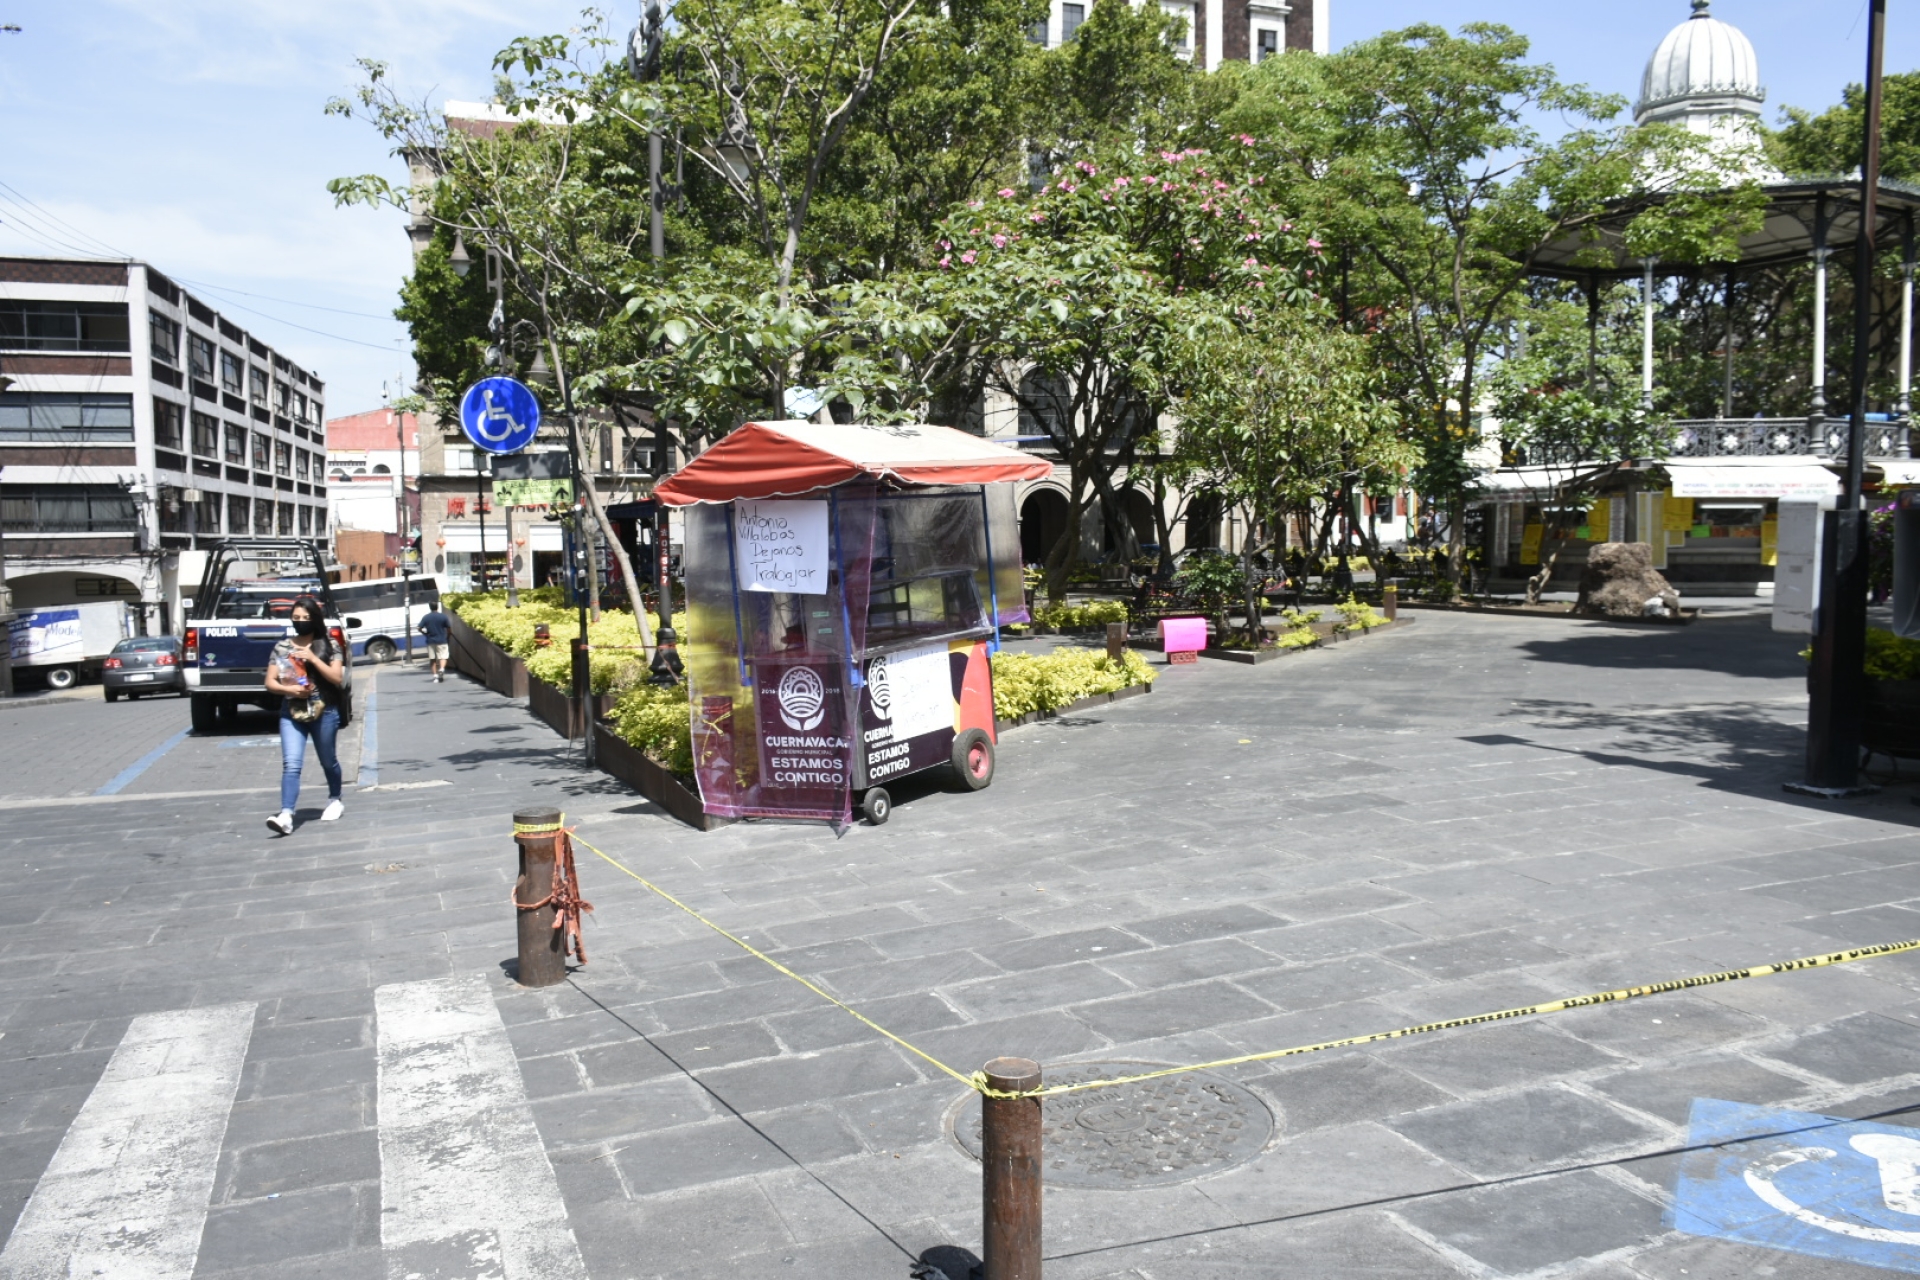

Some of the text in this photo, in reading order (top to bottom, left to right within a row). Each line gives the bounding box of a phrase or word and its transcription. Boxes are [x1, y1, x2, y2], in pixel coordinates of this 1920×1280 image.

[205, 626, 238, 637] POLICÍA
[765, 736, 844, 748] CUERNAVACA
[868, 742, 910, 765] ESTAMOS
[771, 757, 844, 769] ESTAMOS
[869, 757, 911, 779] CONTIGO
[774, 771, 844, 783] CONTIGO
